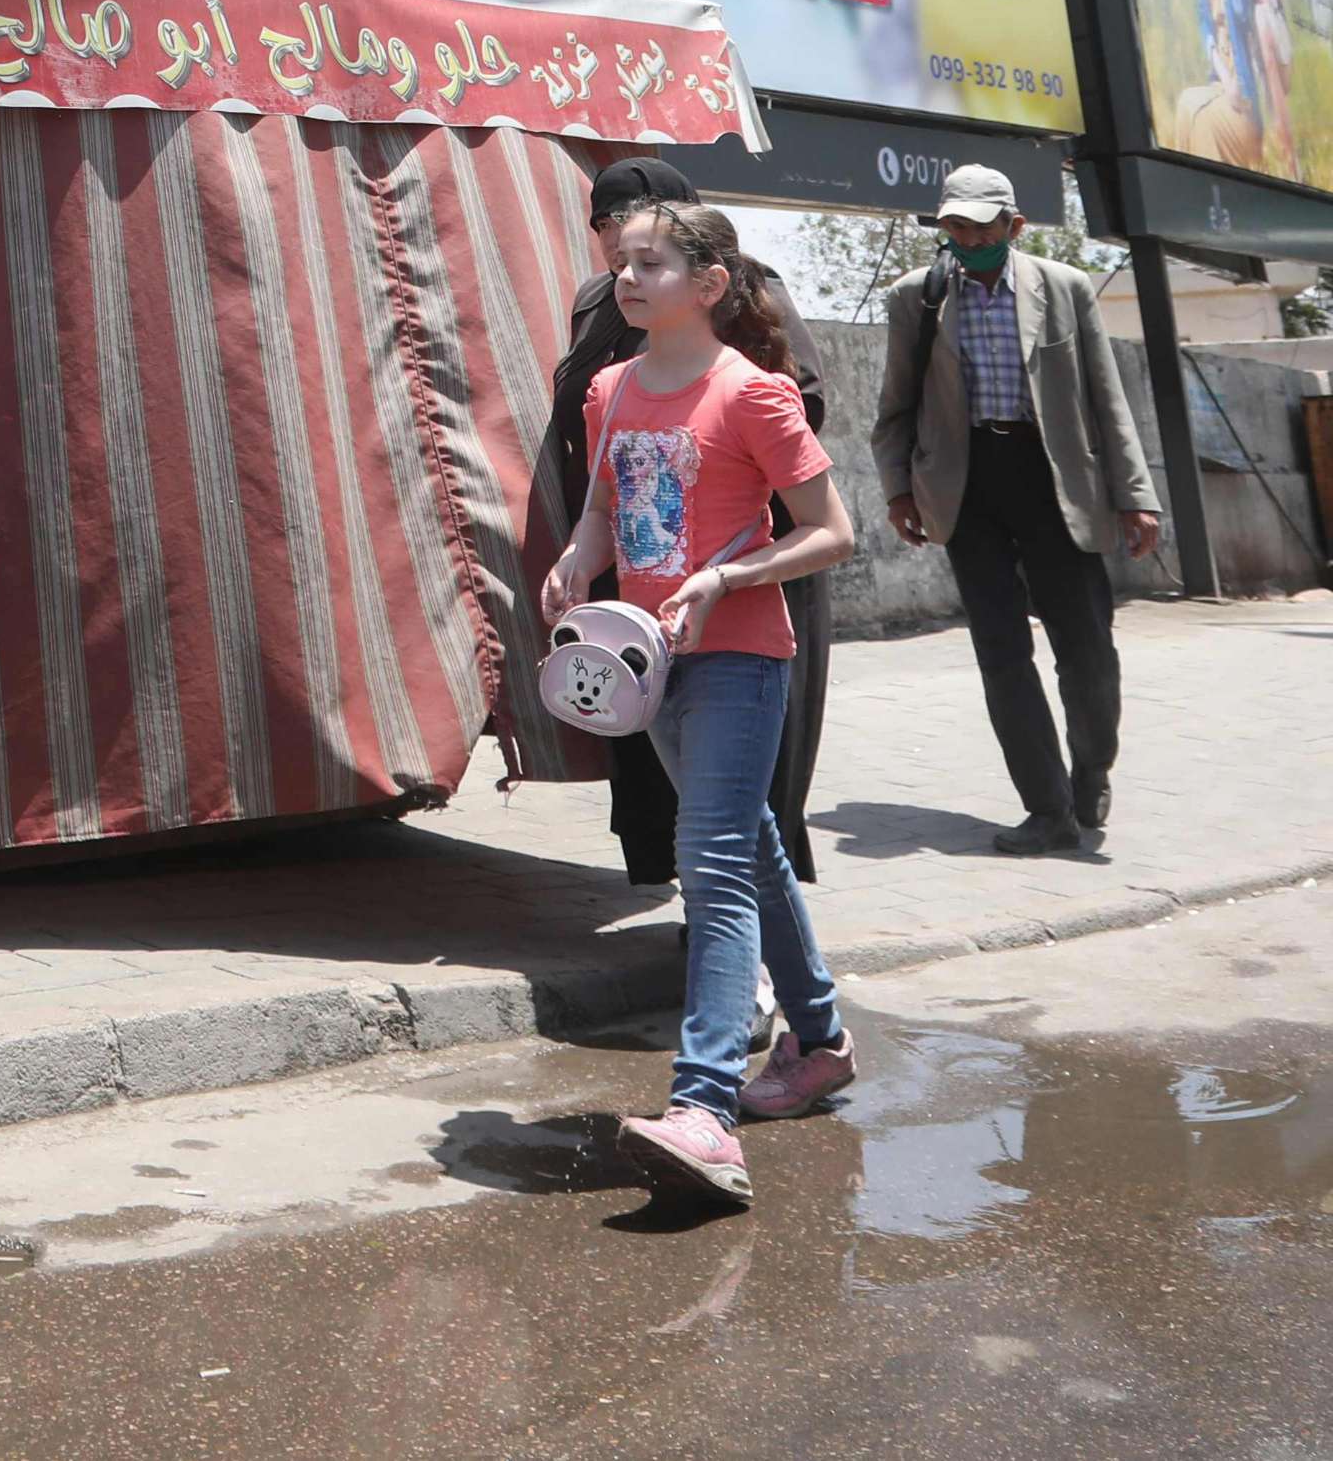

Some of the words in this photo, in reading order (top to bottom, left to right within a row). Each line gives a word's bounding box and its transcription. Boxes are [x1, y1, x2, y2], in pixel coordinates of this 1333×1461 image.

[259, 1, 420, 102] ومالح
[435, 19, 521, 107] حلو
[615, 39, 675, 120] بوشار
[930, 54, 1007, 89] 099-332
[1013, 68, 1036, 93] 98
[1041, 72, 1063, 97] 90
